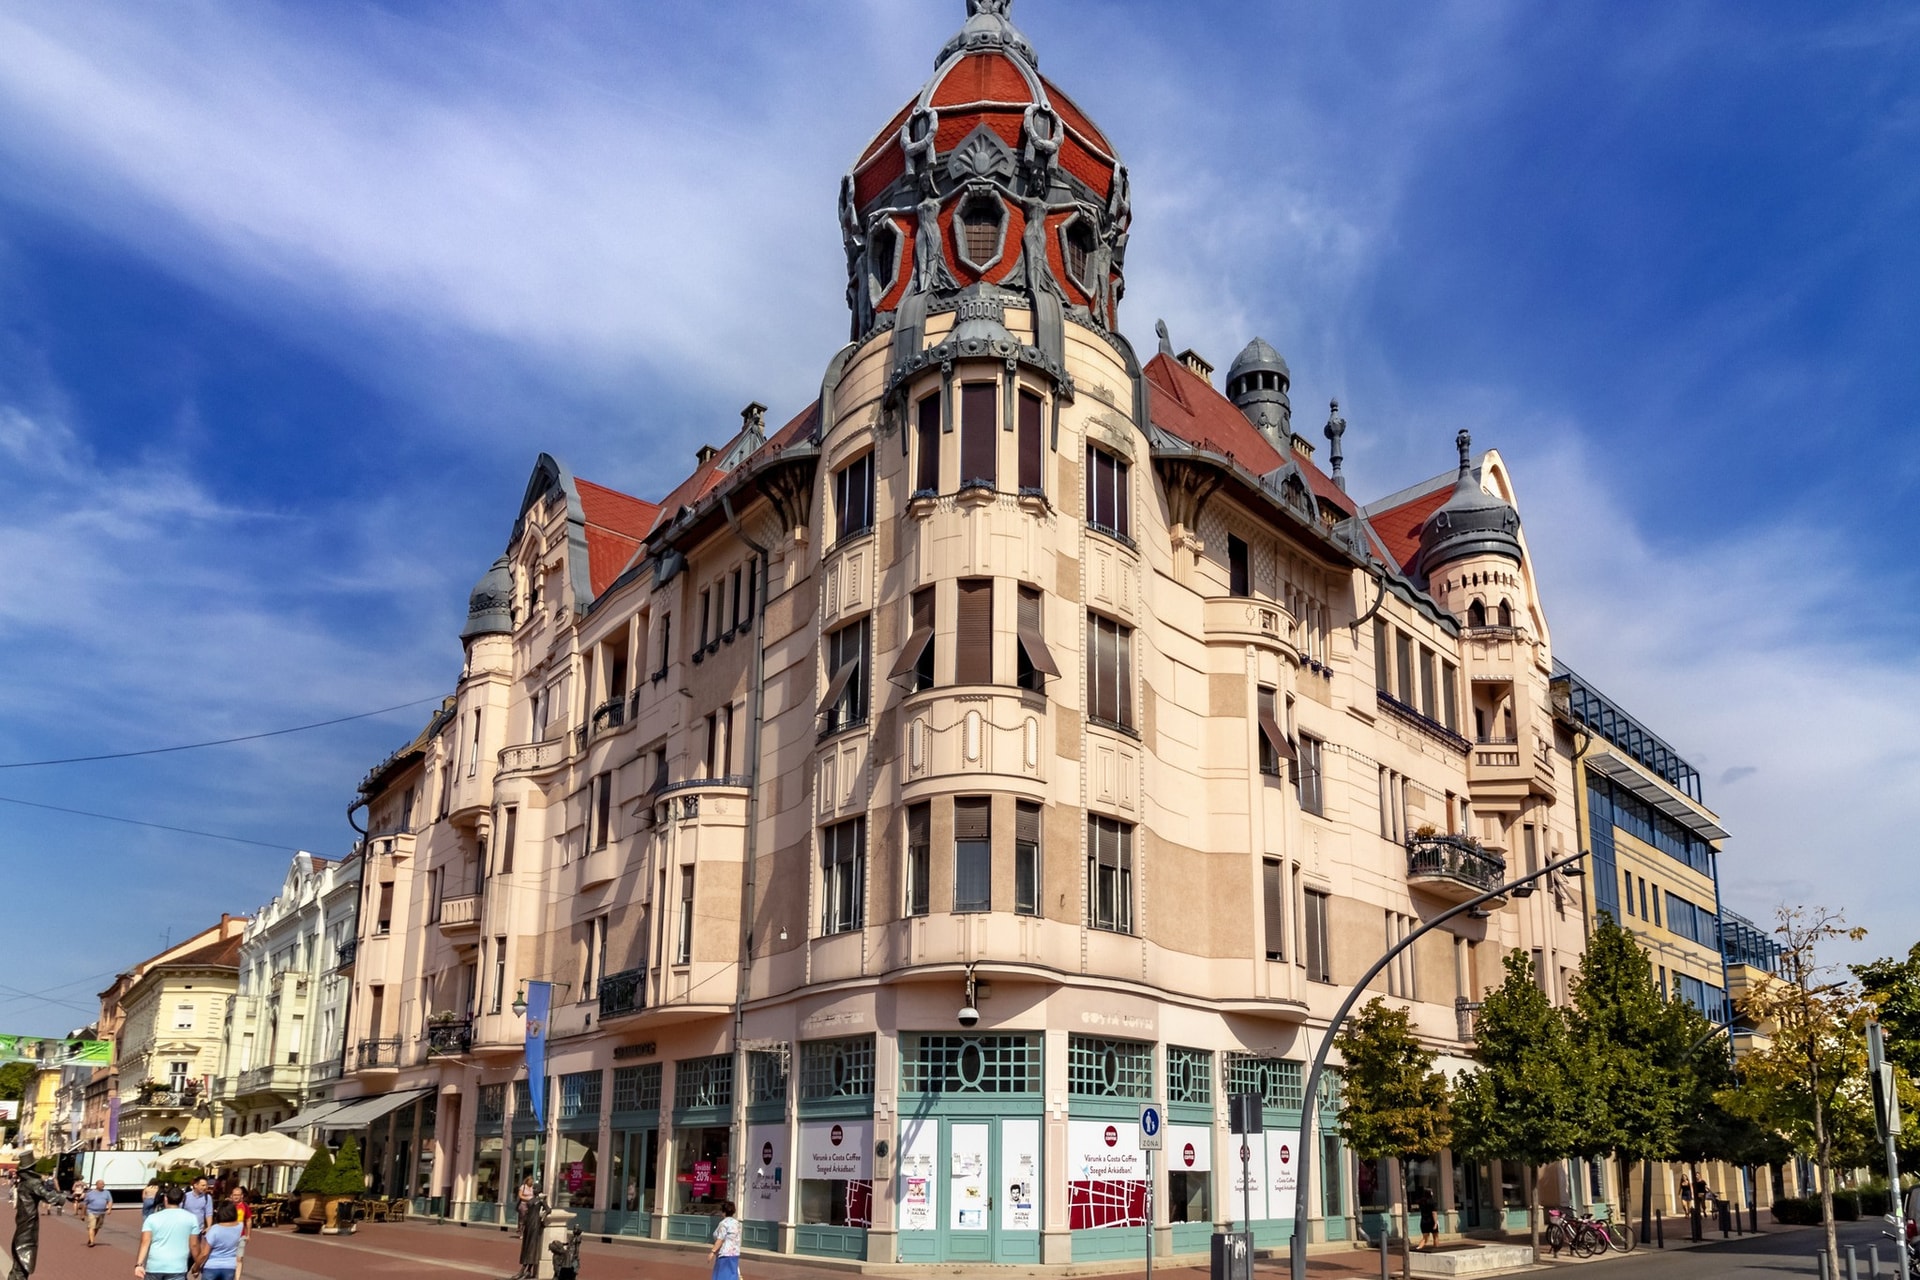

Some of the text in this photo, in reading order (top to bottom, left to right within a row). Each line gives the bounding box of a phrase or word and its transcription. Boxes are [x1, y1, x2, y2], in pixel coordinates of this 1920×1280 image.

[832, 1153, 845, 1161] Costa
[846, 1153, 861, 1161] Coffee
[1106, 1154, 1121, 1162] Costa
[1121, 1155, 1137, 1163] Coffee
[817, 1164, 832, 1175] Szeged
[1090, 1165, 1107, 1177] Szeged
[694, 1171, 710, 1182] -20%
